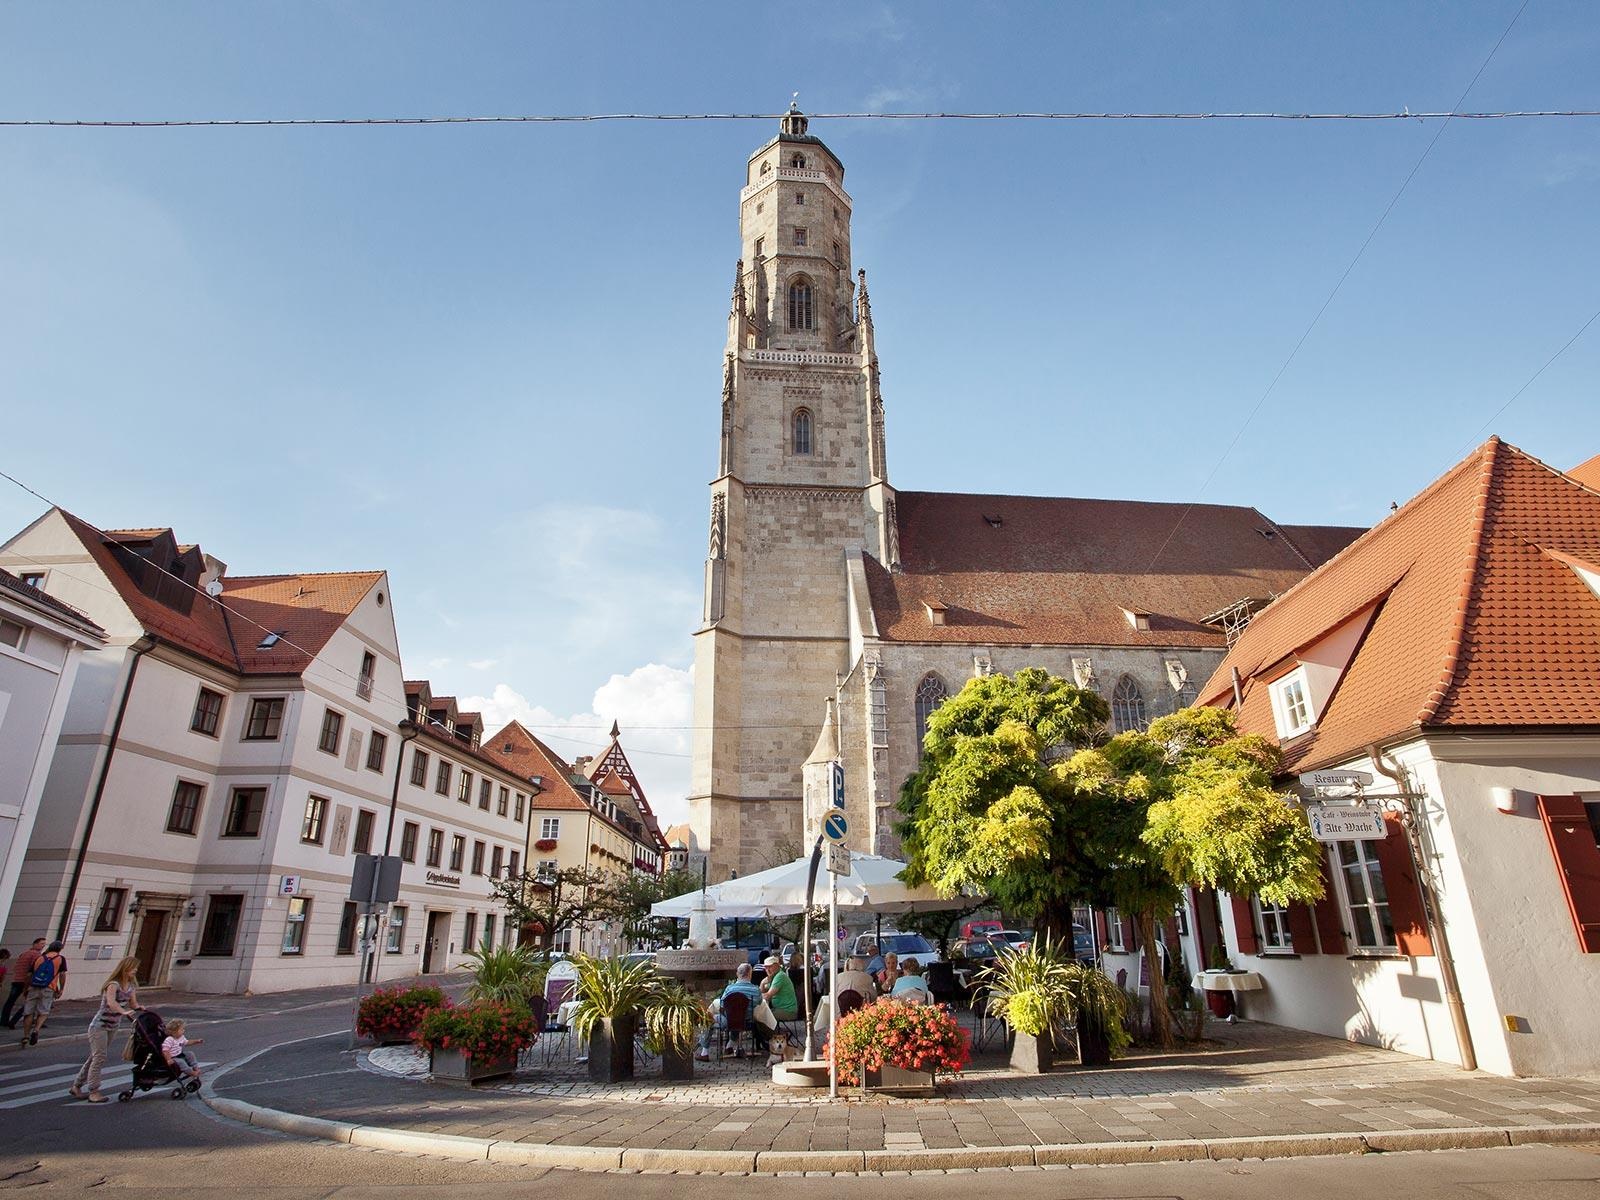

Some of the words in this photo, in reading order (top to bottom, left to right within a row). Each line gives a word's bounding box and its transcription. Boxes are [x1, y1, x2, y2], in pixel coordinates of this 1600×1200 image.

[1313, 773, 1361, 784] Restaurt
[835, 768, 843, 801] P
[1323, 822, 1342, 833] Alte
[1344, 822, 1373, 833] Wache
